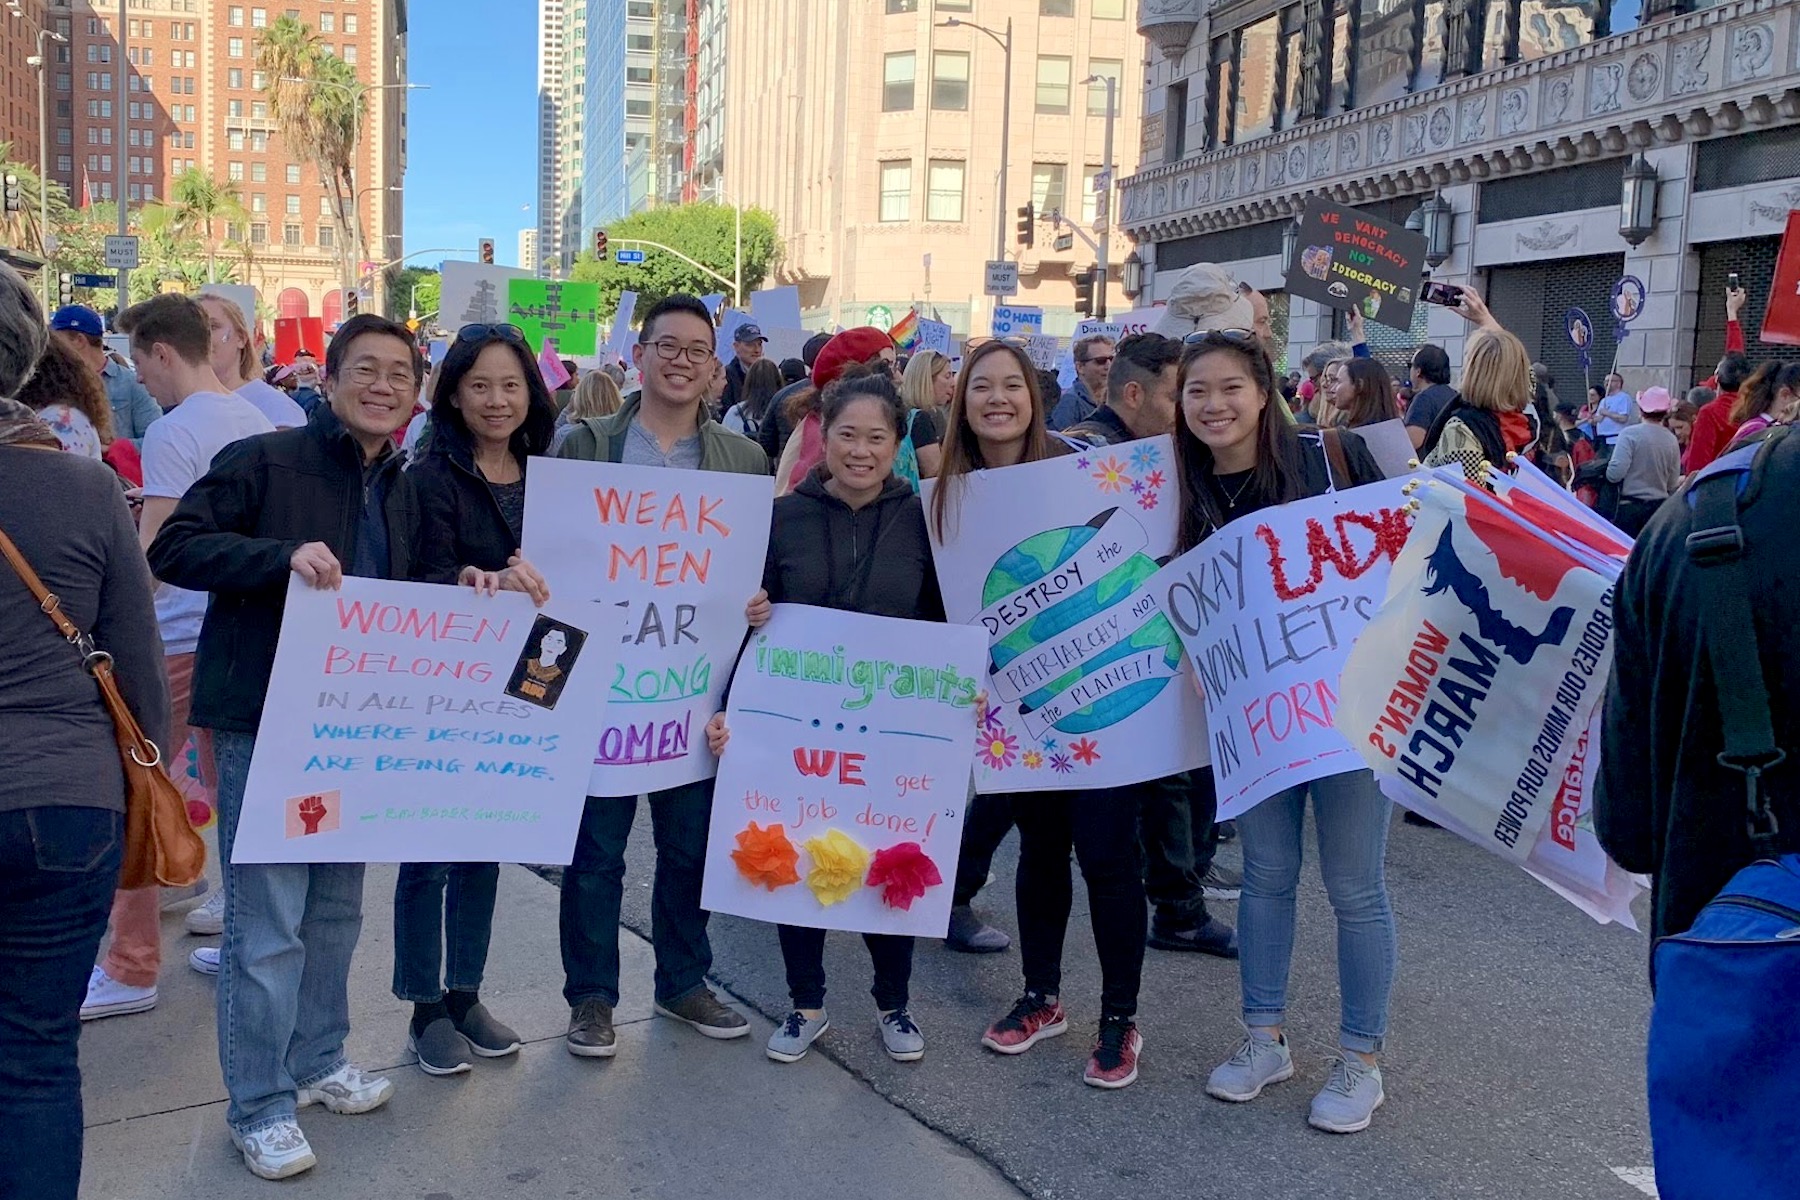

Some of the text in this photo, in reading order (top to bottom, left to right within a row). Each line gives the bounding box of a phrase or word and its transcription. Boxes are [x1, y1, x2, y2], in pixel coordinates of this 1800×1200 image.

[110, 248, 134, 256] MUST
[1334, 231, 1409, 268] DEMOCRACY
[1348, 249, 1375, 266] NOT
[1331, 261, 1397, 295] IDIOCRACY
[993, 322, 1010, 332] NO
[994, 308, 1042, 324] NO HATE
[595, 487, 732, 537] WEAK
[608, 542, 711, 587] MEN
[981, 540, 1122, 637] DESTROY the
[1168, 536, 1245, 637] OKAY
[336, 598, 510, 643] WOMEN
[593, 600, 700, 647] AR
[1132, 593, 1155, 620] NOT
[324, 644, 493, 683] BELONG
[1196, 623, 1248, 713] NOW
[317, 691, 534, 719] IN ALL PLACES
[1040, 654, 1152, 726] the PLANET!
[312, 722, 560, 752] WHERE DECISIONS
[598, 709, 691, 763] OMEN
[1215, 715, 1240, 780] IN
[304, 755, 555, 781] ARE BEING MADE.
[793, 746, 935, 797] WE get
[745, 790, 782, 812] the
[790, 796, 838, 829] job
